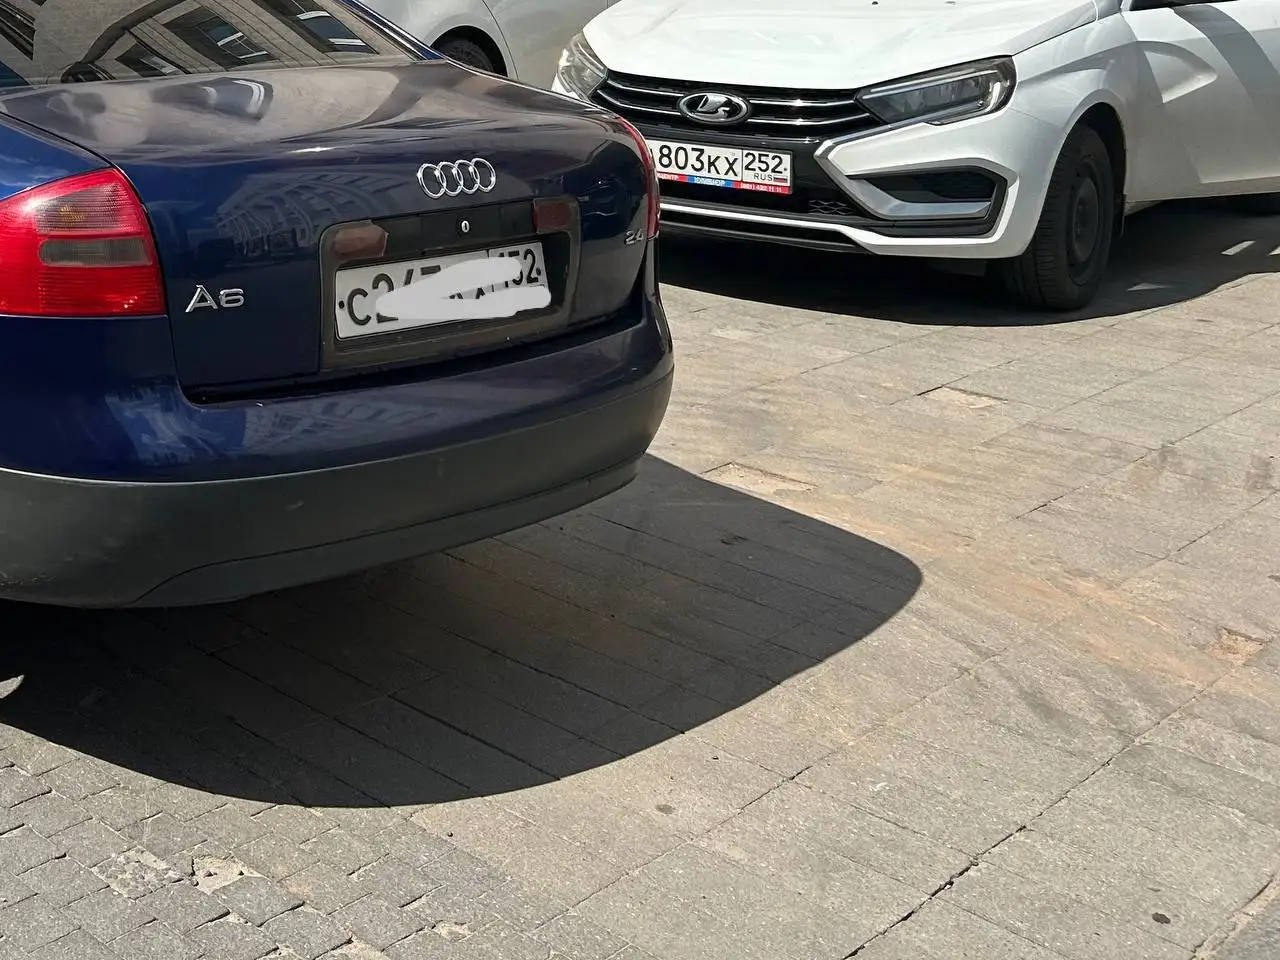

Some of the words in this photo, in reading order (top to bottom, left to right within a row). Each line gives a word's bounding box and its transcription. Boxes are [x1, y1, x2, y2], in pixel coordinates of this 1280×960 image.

[651, 144, 738, 177] 803КХ
[744, 151, 783, 174] 252
[754, 173, 773, 181] RUS
[185, 284, 245, 313] A6
